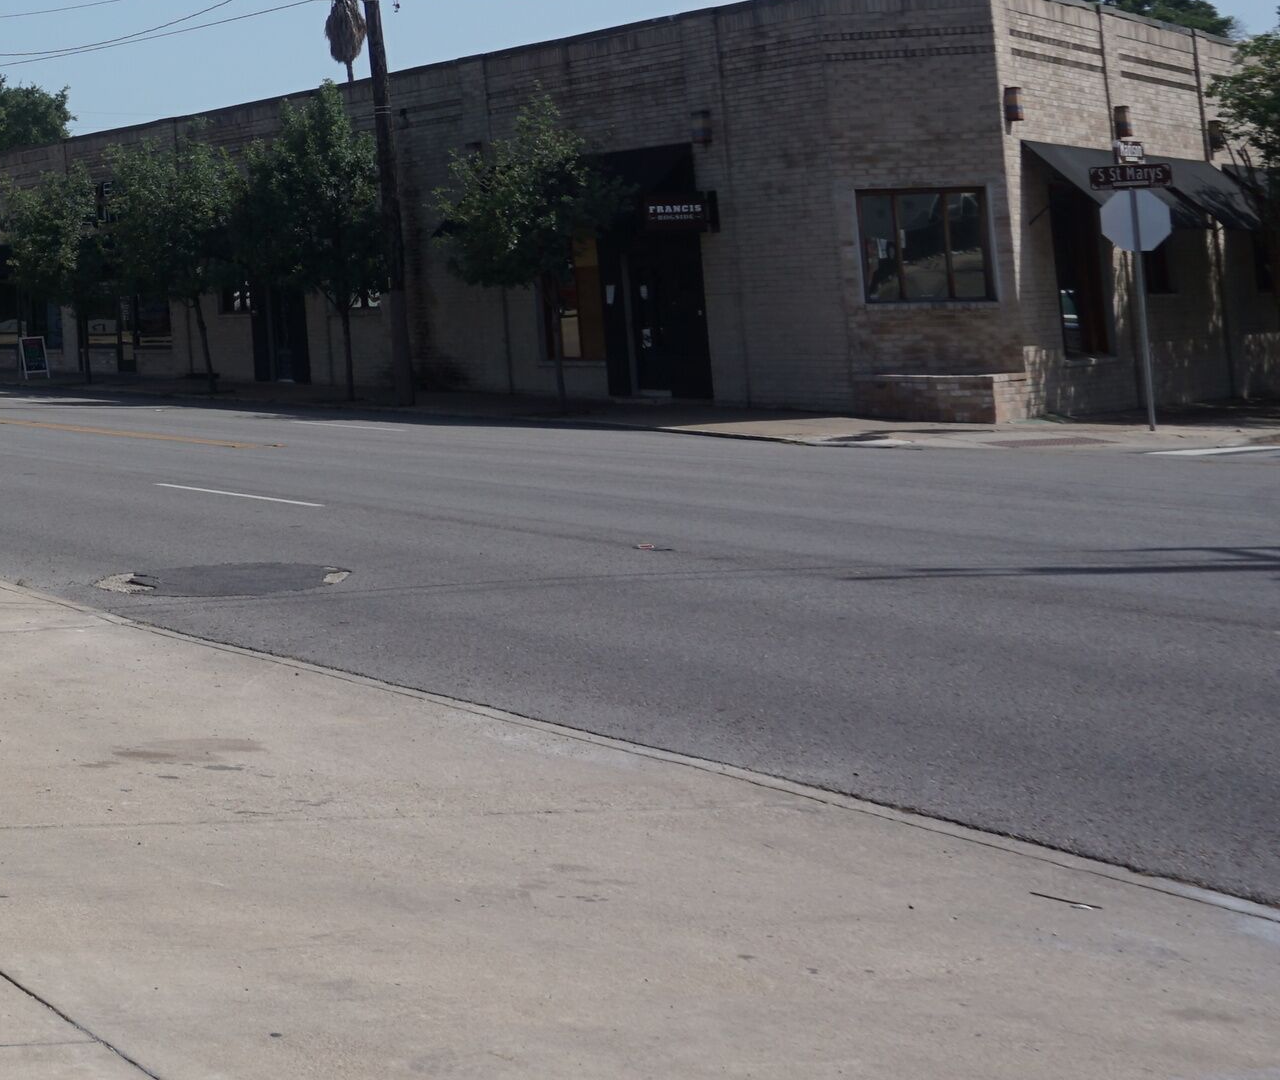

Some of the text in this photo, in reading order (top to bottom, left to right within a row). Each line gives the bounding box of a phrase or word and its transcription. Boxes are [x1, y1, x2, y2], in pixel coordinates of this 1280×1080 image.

[1098, 166, 1163, 182] S St Marys
[648, 204, 702, 213] FRANCIS
